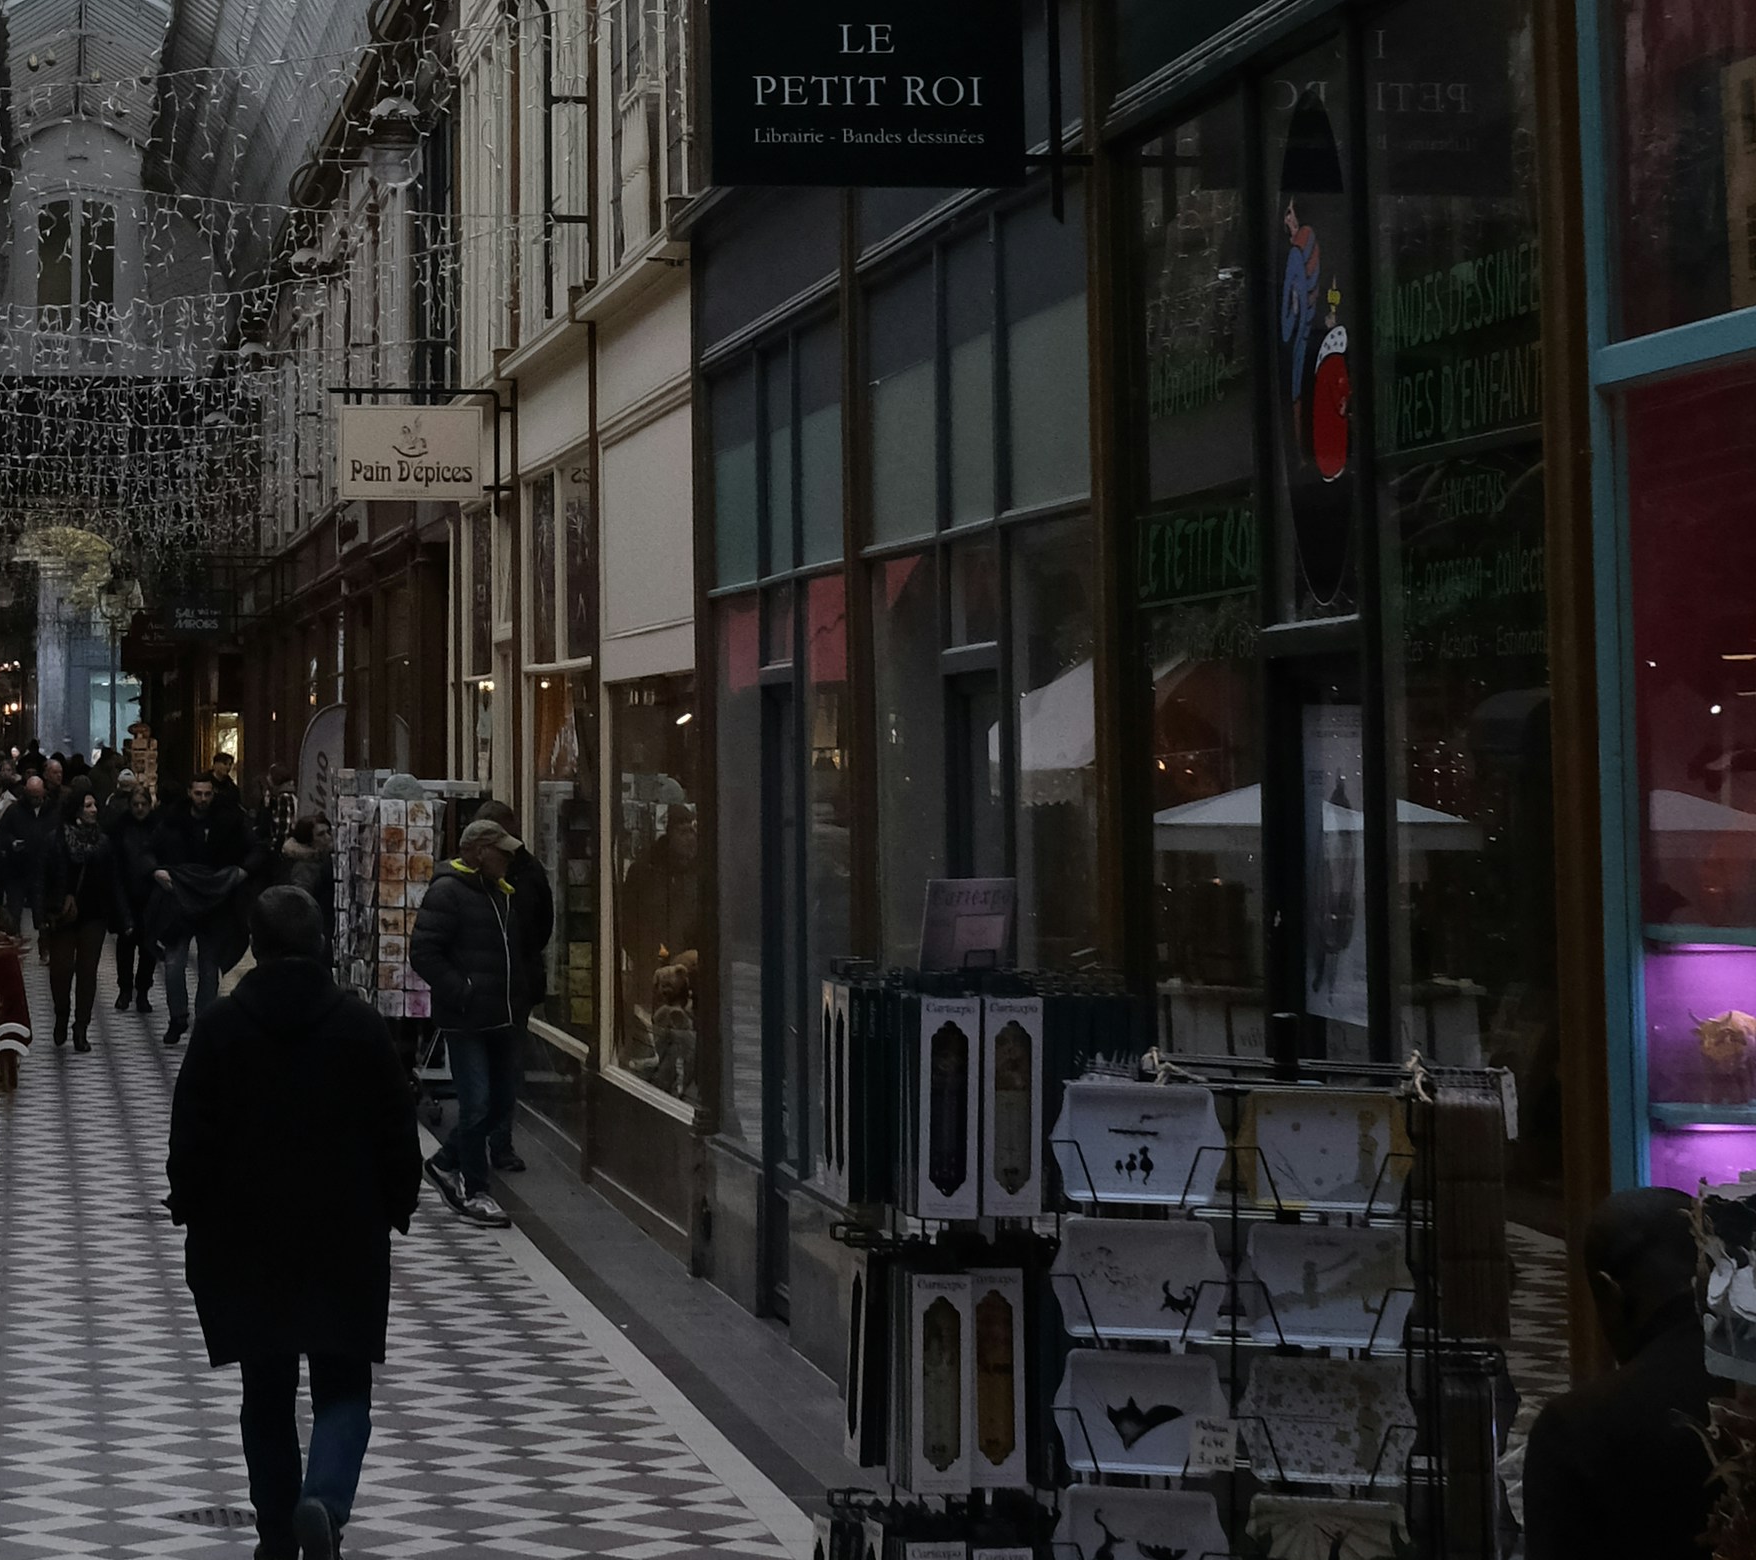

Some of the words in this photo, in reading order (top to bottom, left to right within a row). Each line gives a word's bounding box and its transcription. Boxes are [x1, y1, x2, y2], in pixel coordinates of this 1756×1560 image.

[837, 23, 895, 54] LE
[752, 75, 886, 107] PETIT
[901, 75, 984, 107] ROI
[753, 128, 825, 144] Librairie
[841, 128, 902, 145] Bandes
[907, 128, 985, 145] dessinées
[350, 459, 392, 482] Pain
[397, 459, 473, 488] D'épices
